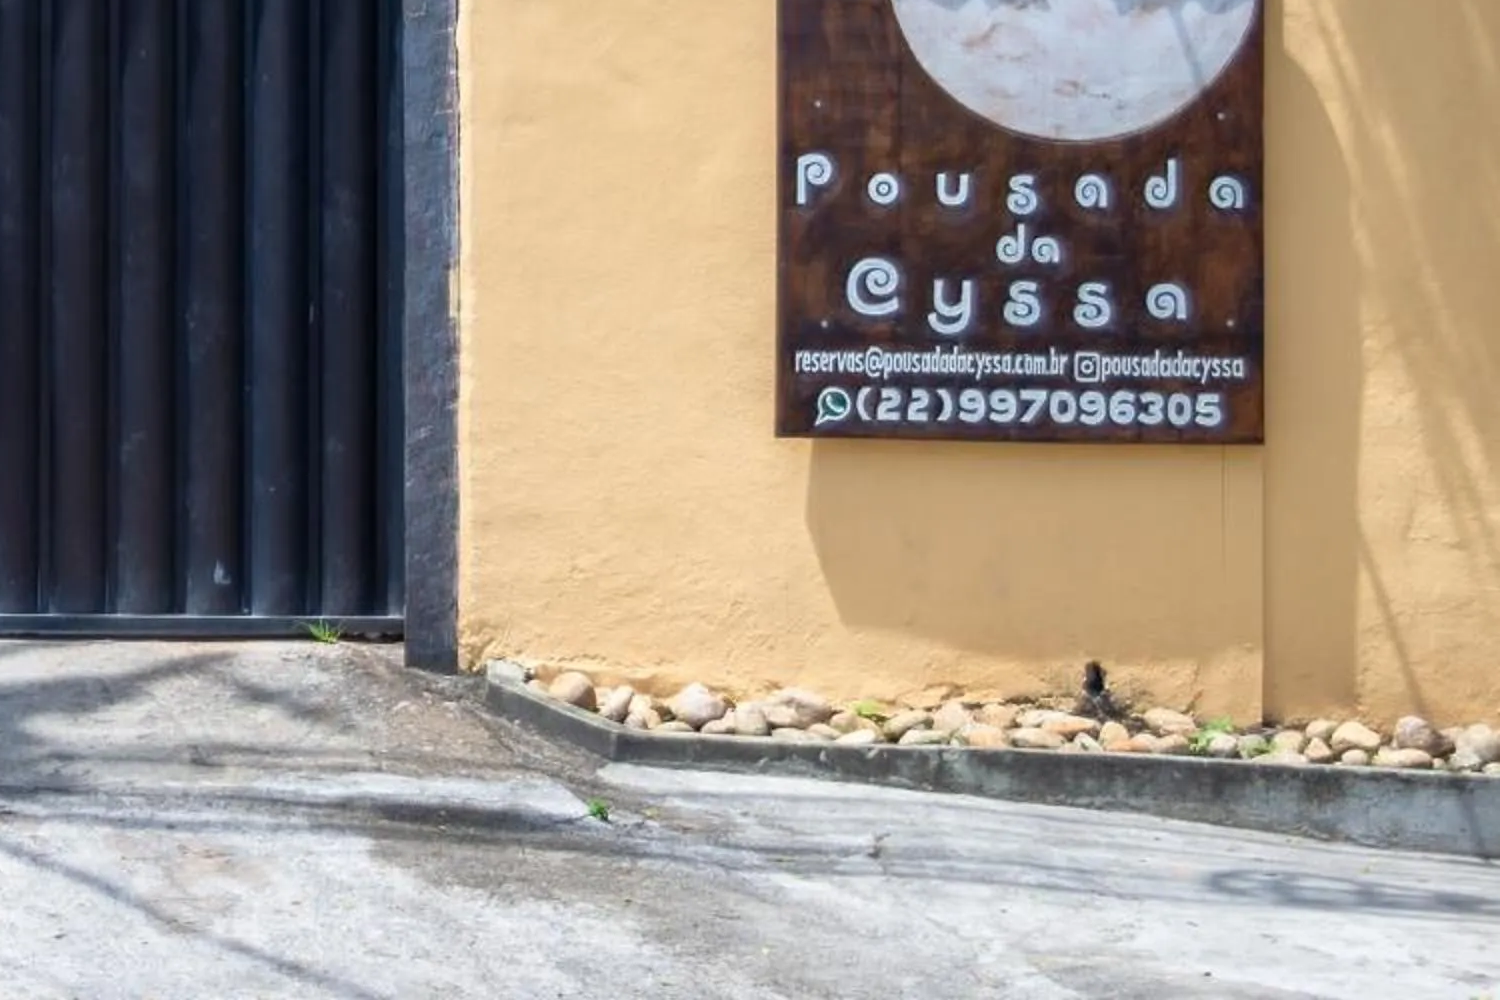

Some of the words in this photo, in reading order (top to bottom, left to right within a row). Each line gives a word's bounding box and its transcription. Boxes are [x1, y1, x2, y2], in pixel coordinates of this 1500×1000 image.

[795, 153, 1244, 215] Pousada
[996, 223, 1061, 264] da
[846, 257, 1189, 334] Cyssa
[794, 345, 1068, 380] reservas@pousadadacyssa.com.br
[1101, 349, 1245, 384] pousadadacyssa
[855, 386, 1223, 426] (22)997096305
